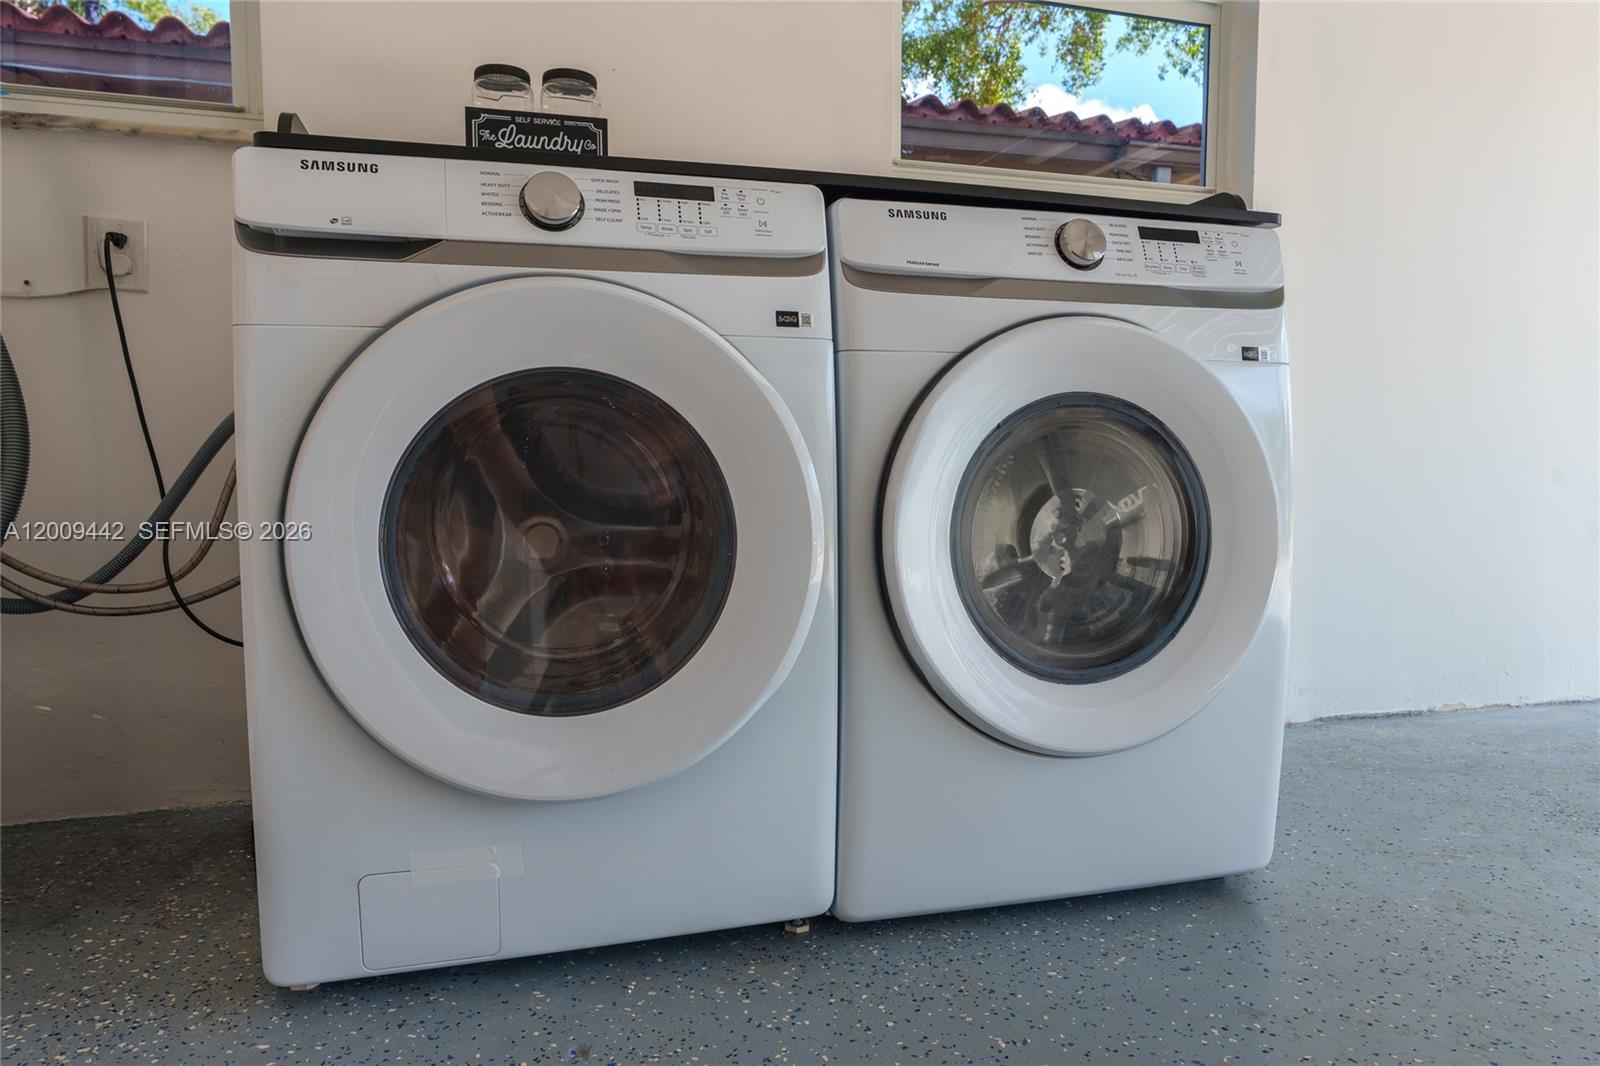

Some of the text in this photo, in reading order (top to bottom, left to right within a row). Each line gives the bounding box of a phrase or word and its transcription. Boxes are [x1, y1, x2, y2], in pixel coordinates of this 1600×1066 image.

[514, 116, 562, 126] SELF SERVICE
[479, 129, 497, 141] The
[495, 124, 584, 154] Laundry
[300, 159, 379, 174] SAMSUNG
[888, 208, 948, 221] SAMSUNG
